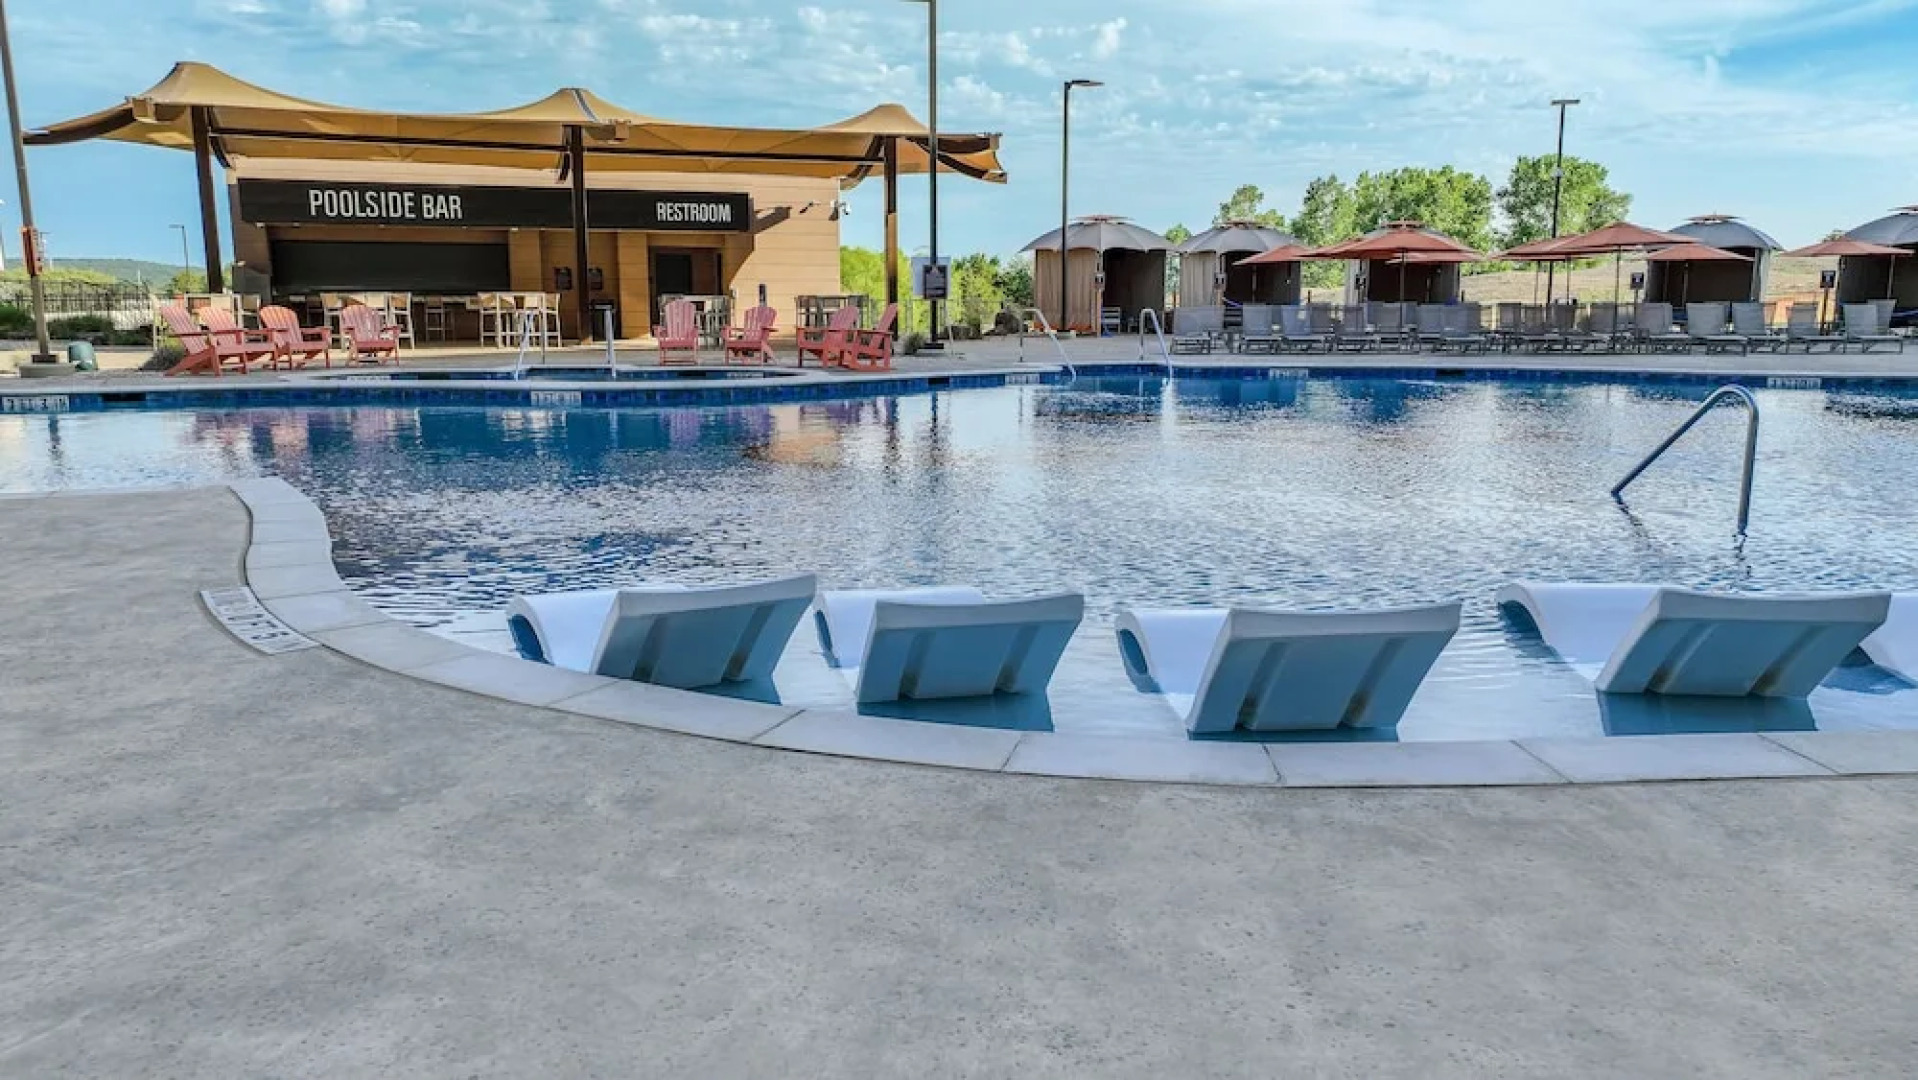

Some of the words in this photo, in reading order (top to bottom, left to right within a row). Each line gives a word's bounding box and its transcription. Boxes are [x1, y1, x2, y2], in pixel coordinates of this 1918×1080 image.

[309, 189, 416, 218] POOLSIDE
[421, 194, 463, 219] BAR
[656, 202, 732, 223] RESTROOM
